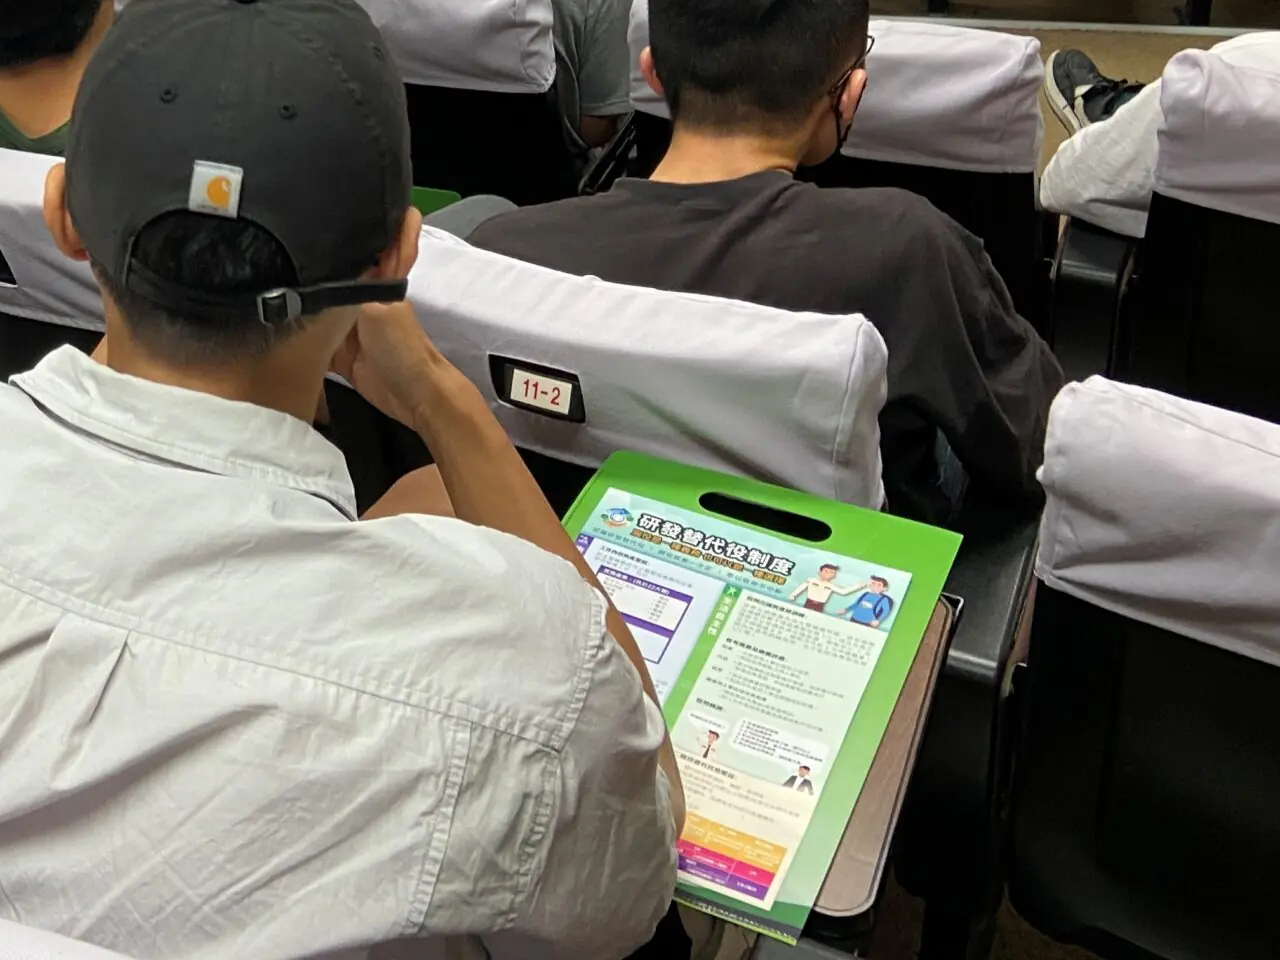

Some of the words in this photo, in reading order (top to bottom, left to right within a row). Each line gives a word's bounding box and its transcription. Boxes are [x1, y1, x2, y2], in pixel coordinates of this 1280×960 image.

[523, 378, 561, 406] 11-2
[637, 513, 796, 576] 研發替代役制度
